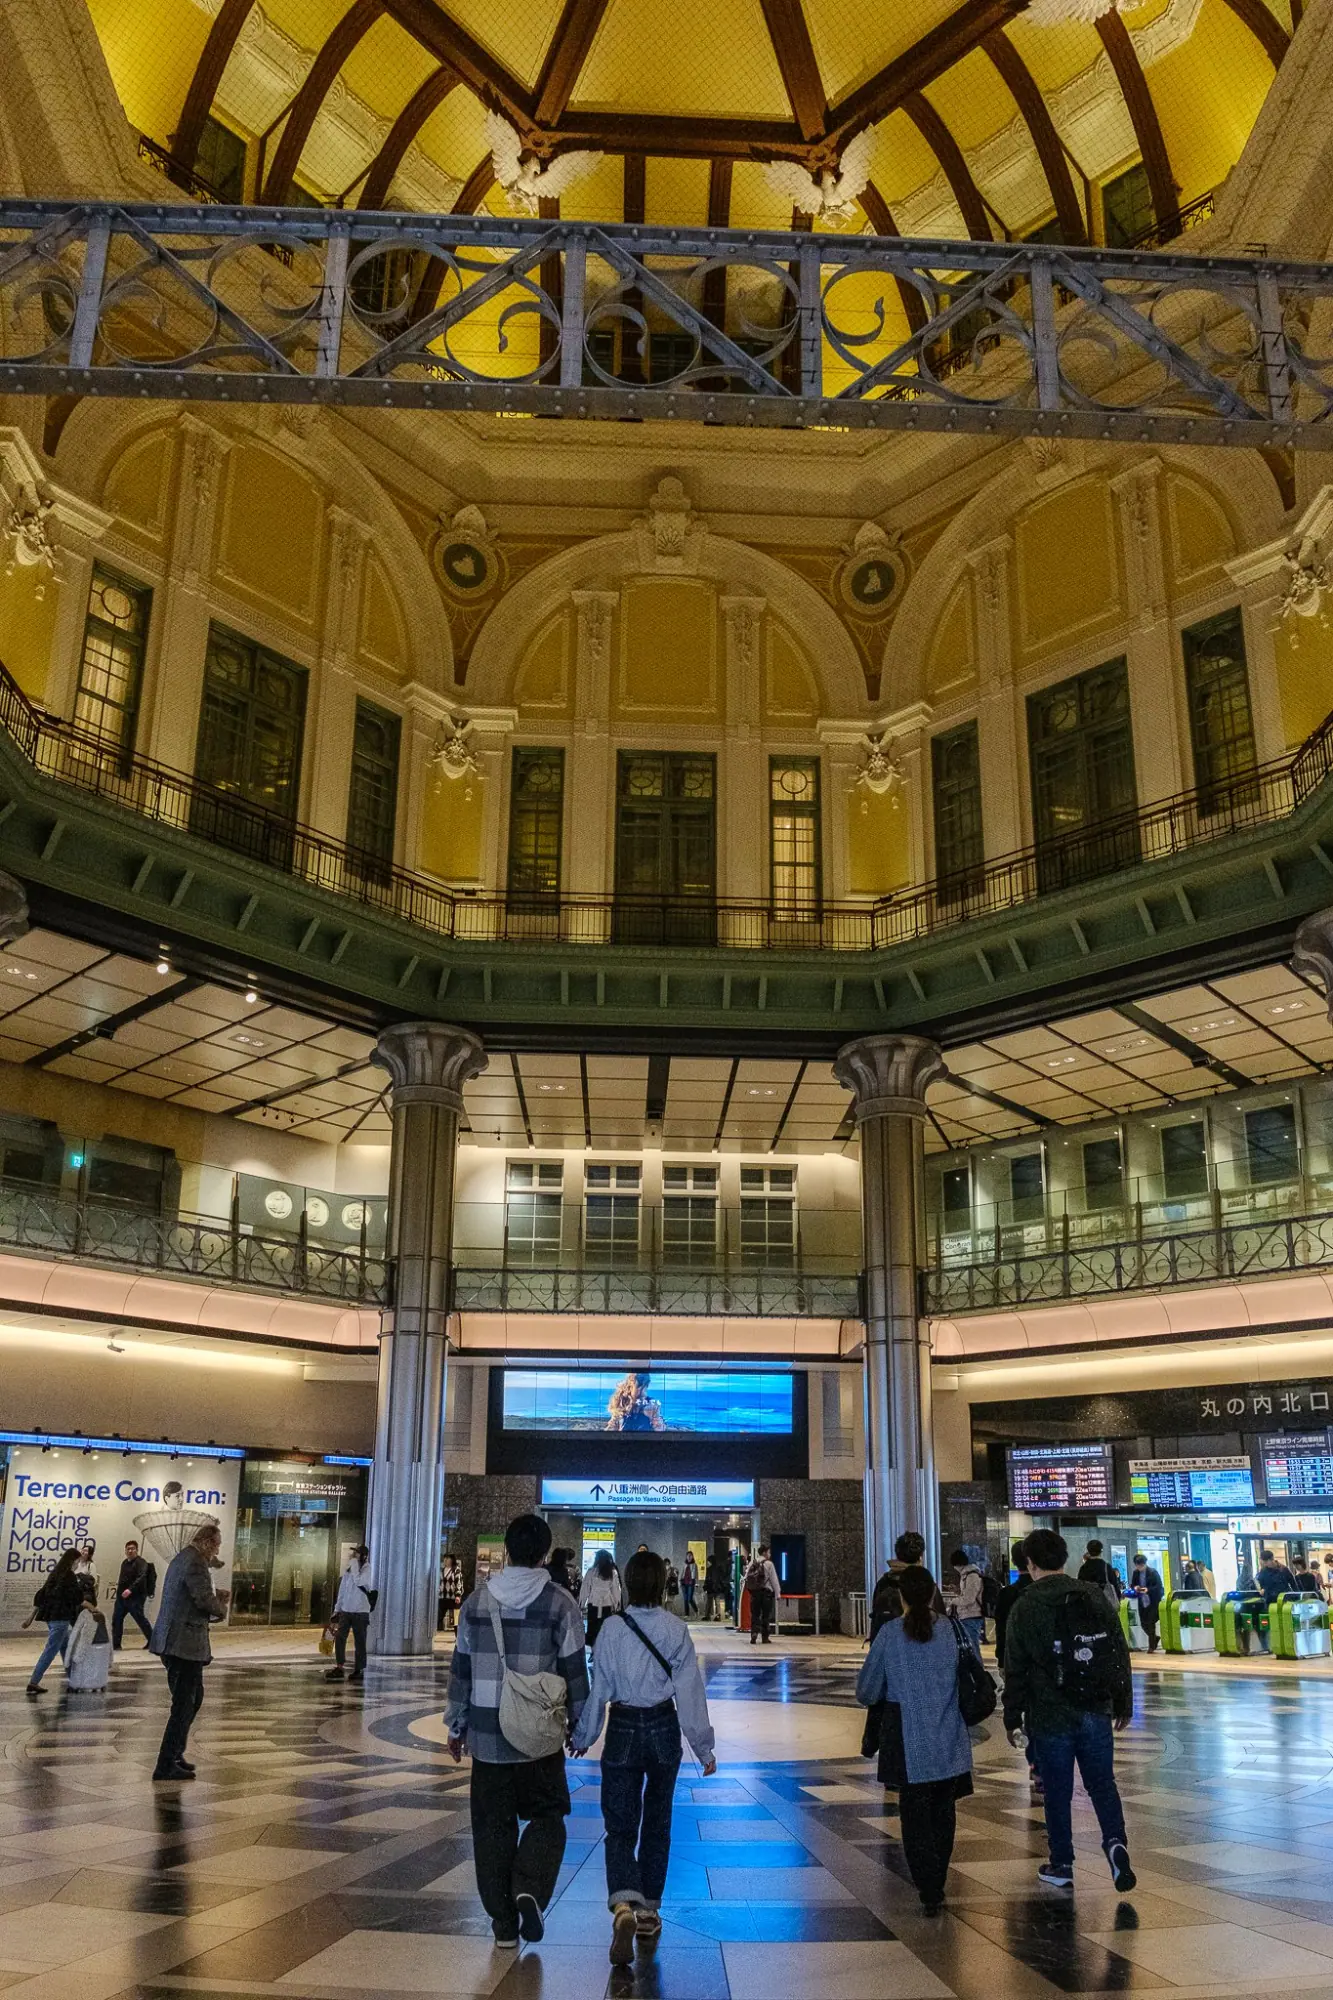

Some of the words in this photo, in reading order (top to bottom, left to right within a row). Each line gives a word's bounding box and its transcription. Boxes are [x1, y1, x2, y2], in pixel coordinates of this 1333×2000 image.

[1200, 1392, 1329, 1417] 丸の内北口
[14, 1475, 111, 1501] Terence
[608, 1483, 707, 1496] 八重洲側への自由通路
[12, 1507, 90, 1537] Making
[9, 1529, 96, 1552] Modern
[1181, 1536, 1187, 1554] 1
[1221, 1538, 1229, 1550] 2
[1237, 1538, 1244, 1555] 2
[6, 1551, 63, 1573] Brita
